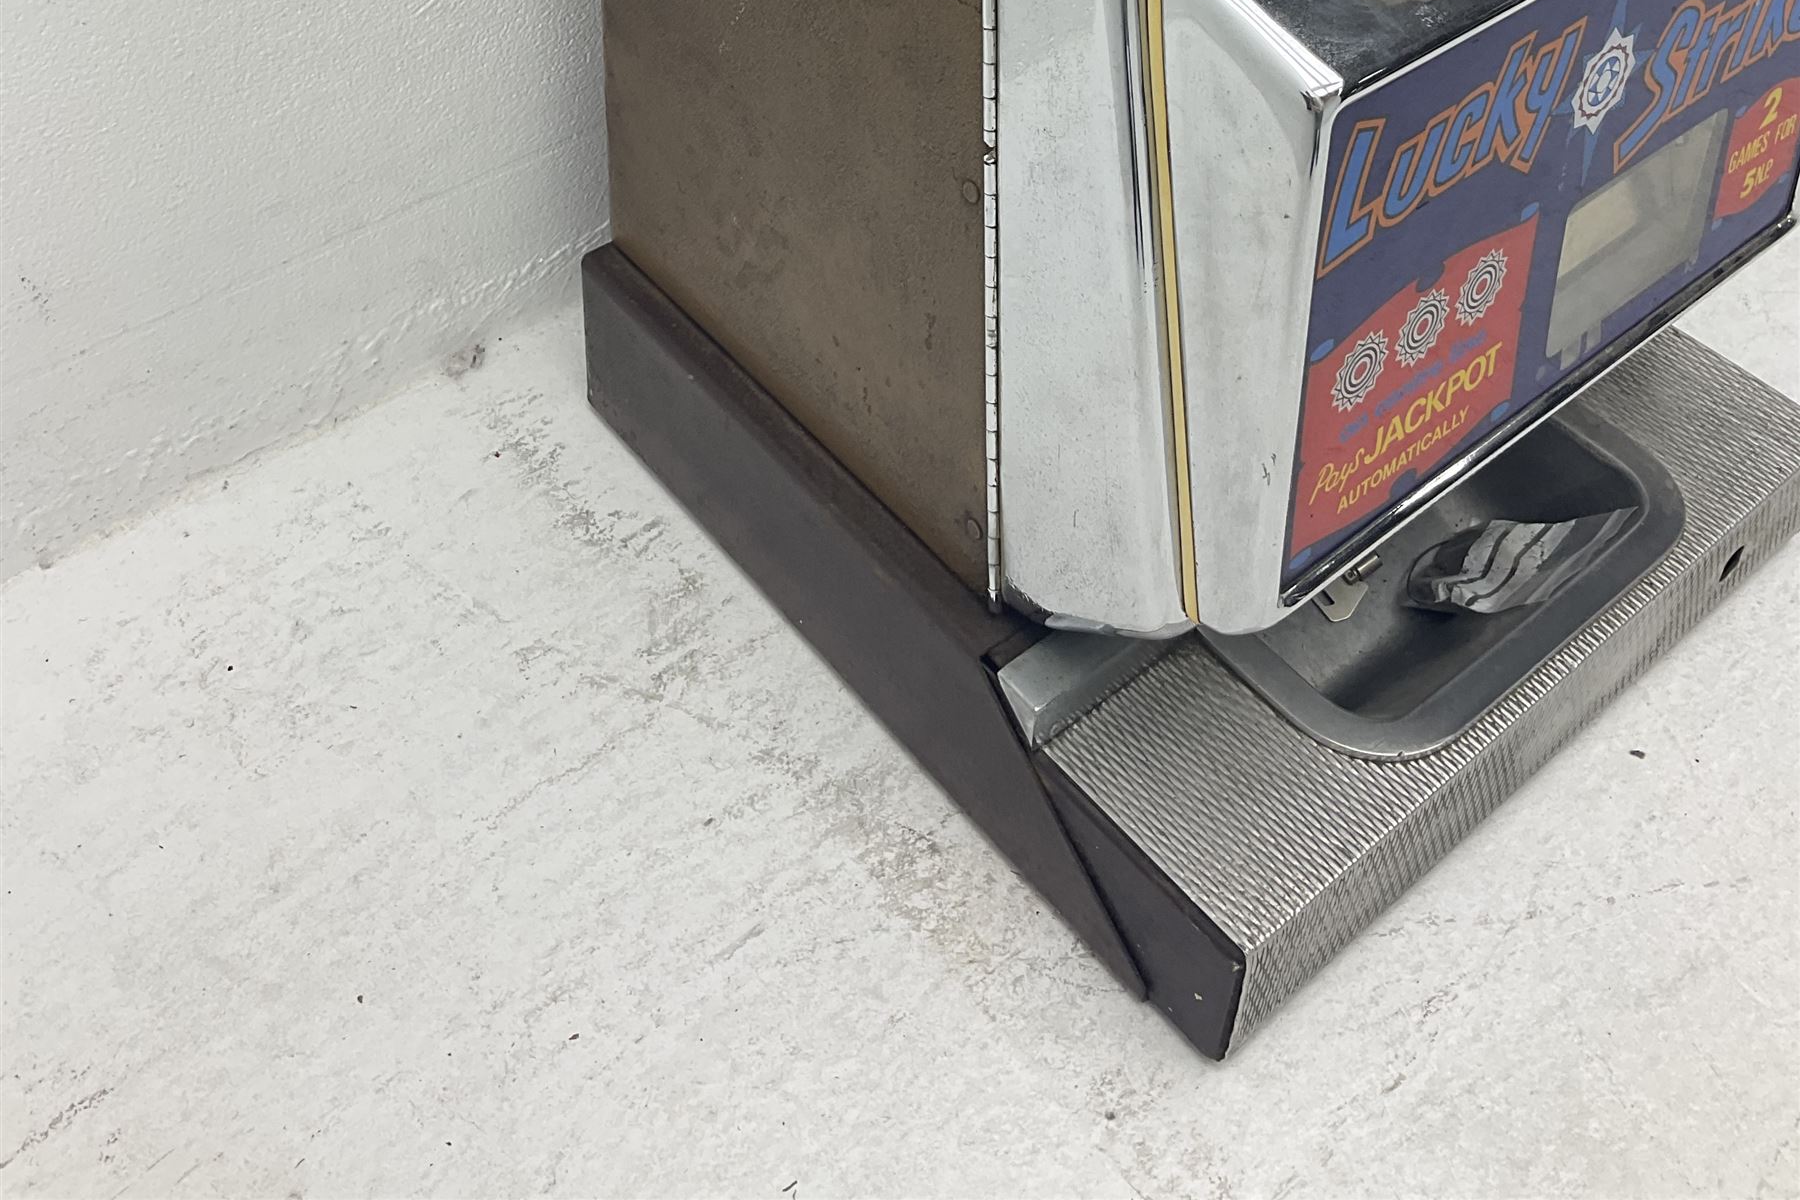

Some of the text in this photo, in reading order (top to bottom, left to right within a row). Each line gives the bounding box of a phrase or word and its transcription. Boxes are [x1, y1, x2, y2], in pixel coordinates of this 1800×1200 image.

[1728, 113, 1798, 174] GAMES FOR
[1759, 87, 1783, 130] 2
[1308, 447, 1365, 506] Pays
[1364, 341, 1503, 465] JACKPOT
[1337, 404, 1470, 514] AUTOMATICALLY
